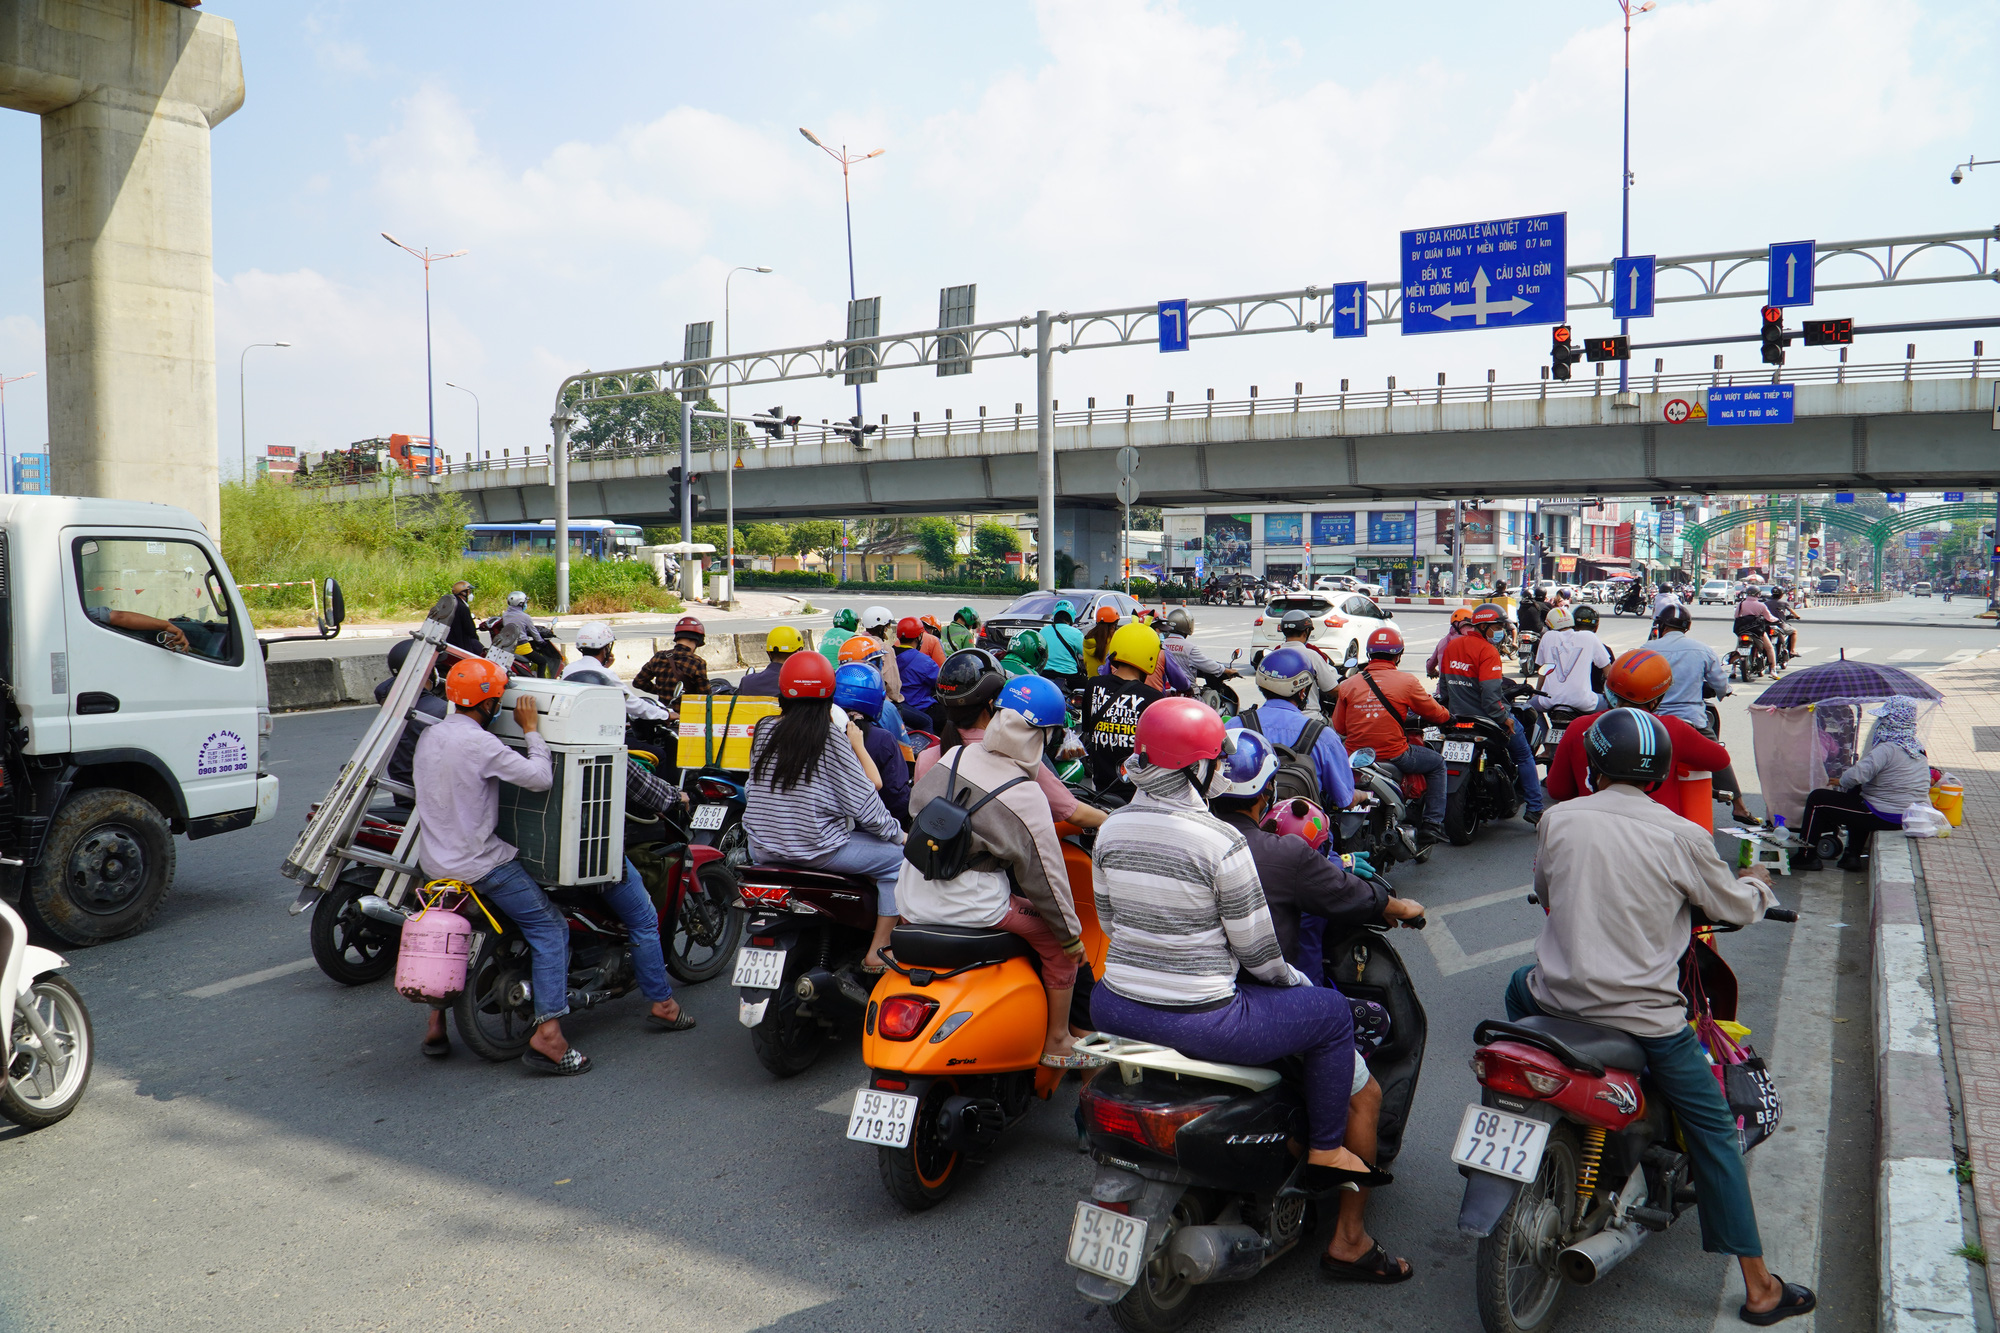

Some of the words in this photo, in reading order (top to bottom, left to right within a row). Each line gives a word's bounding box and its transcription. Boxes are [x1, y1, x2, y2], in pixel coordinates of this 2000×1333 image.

[1416, 232, 1427, 245] BV
[1430, 231, 1441, 243] ĐA
[1444, 228, 1467, 242] KHOA
[1469, 223, 1480, 239] LÊ
[1482, 222, 1498, 237] VĂN
[1500, 220, 1519, 237] VIỆT
[1412, 251, 1420, 261] BV
[1424, 248, 1442, 260] QUÂN
[1446, 246, 1461, 258] DÂN
[1466, 245, 1472, 255] Y
[1477, 240, 1494, 254] MIỀN
[1499, 240, 1517, 252] ĐÔNG
[1526, 238, 1536, 248] 0.7
[1540, 237, 1552, 247] km
[1422, 264, 1437, 281] BẾN
[1442, 267, 1452, 279] XE
[1516, 262, 1530, 278] SÀI
[1533, 261, 1551, 276] GÒN
[1406, 281, 1425, 298] MIỀN
[1430, 282, 1450, 296] ĐÔNG
[1455, 278, 1470, 294] MỚI
[1518, 285, 1524, 294] 9
[1526, 284, 1540, 294] km
[1410, 302, 1416, 313] 6
[1418, 301, 1432, 313] km
[1823, 320, 1850, 342] 42
[1764, 390, 1779, 399] THÉP
[1782, 391, 1792, 400] TẠI
[1722, 409, 1734, 418] NGÃ
[1737, 409, 1746, 417] TƯ
[1749, 408, 1761, 417] THỦ
[1766, 408, 1778, 416] ĐỨC
[268, 446, 295, 456] HOTEL
[1120, 716, 1138, 725] JUST
[221, 730, 241, 742] ANH
[1448, 743, 1469, 752] 59-N2
[1444, 751, 1470, 760] 999.33
[198, 767, 216, 775] 0908
[700, 807, 721, 817] 76-G1
[693, 818, 721, 828] 398.45
[744, 951, 778, 968] 79-C1
[735, 968, 778, 986] 201.24
[946, 1058, 977, 1066] Sprint
[863, 1093, 907, 1119] 59-X3
[1498, 1099, 1524, 1109] HONDA
[852, 1115, 905, 1143] 719.33
[1474, 1112, 1536, 1146] 68-T7
[1226, 1133, 1287, 1144] LEAD
[1465, 1137, 1527, 1175] 7212
[1110, 1156, 1140, 1170] HONDA
[1083, 1209, 1135, 1248] 54-R2
[1077, 1238, 1128, 1276] 7309
